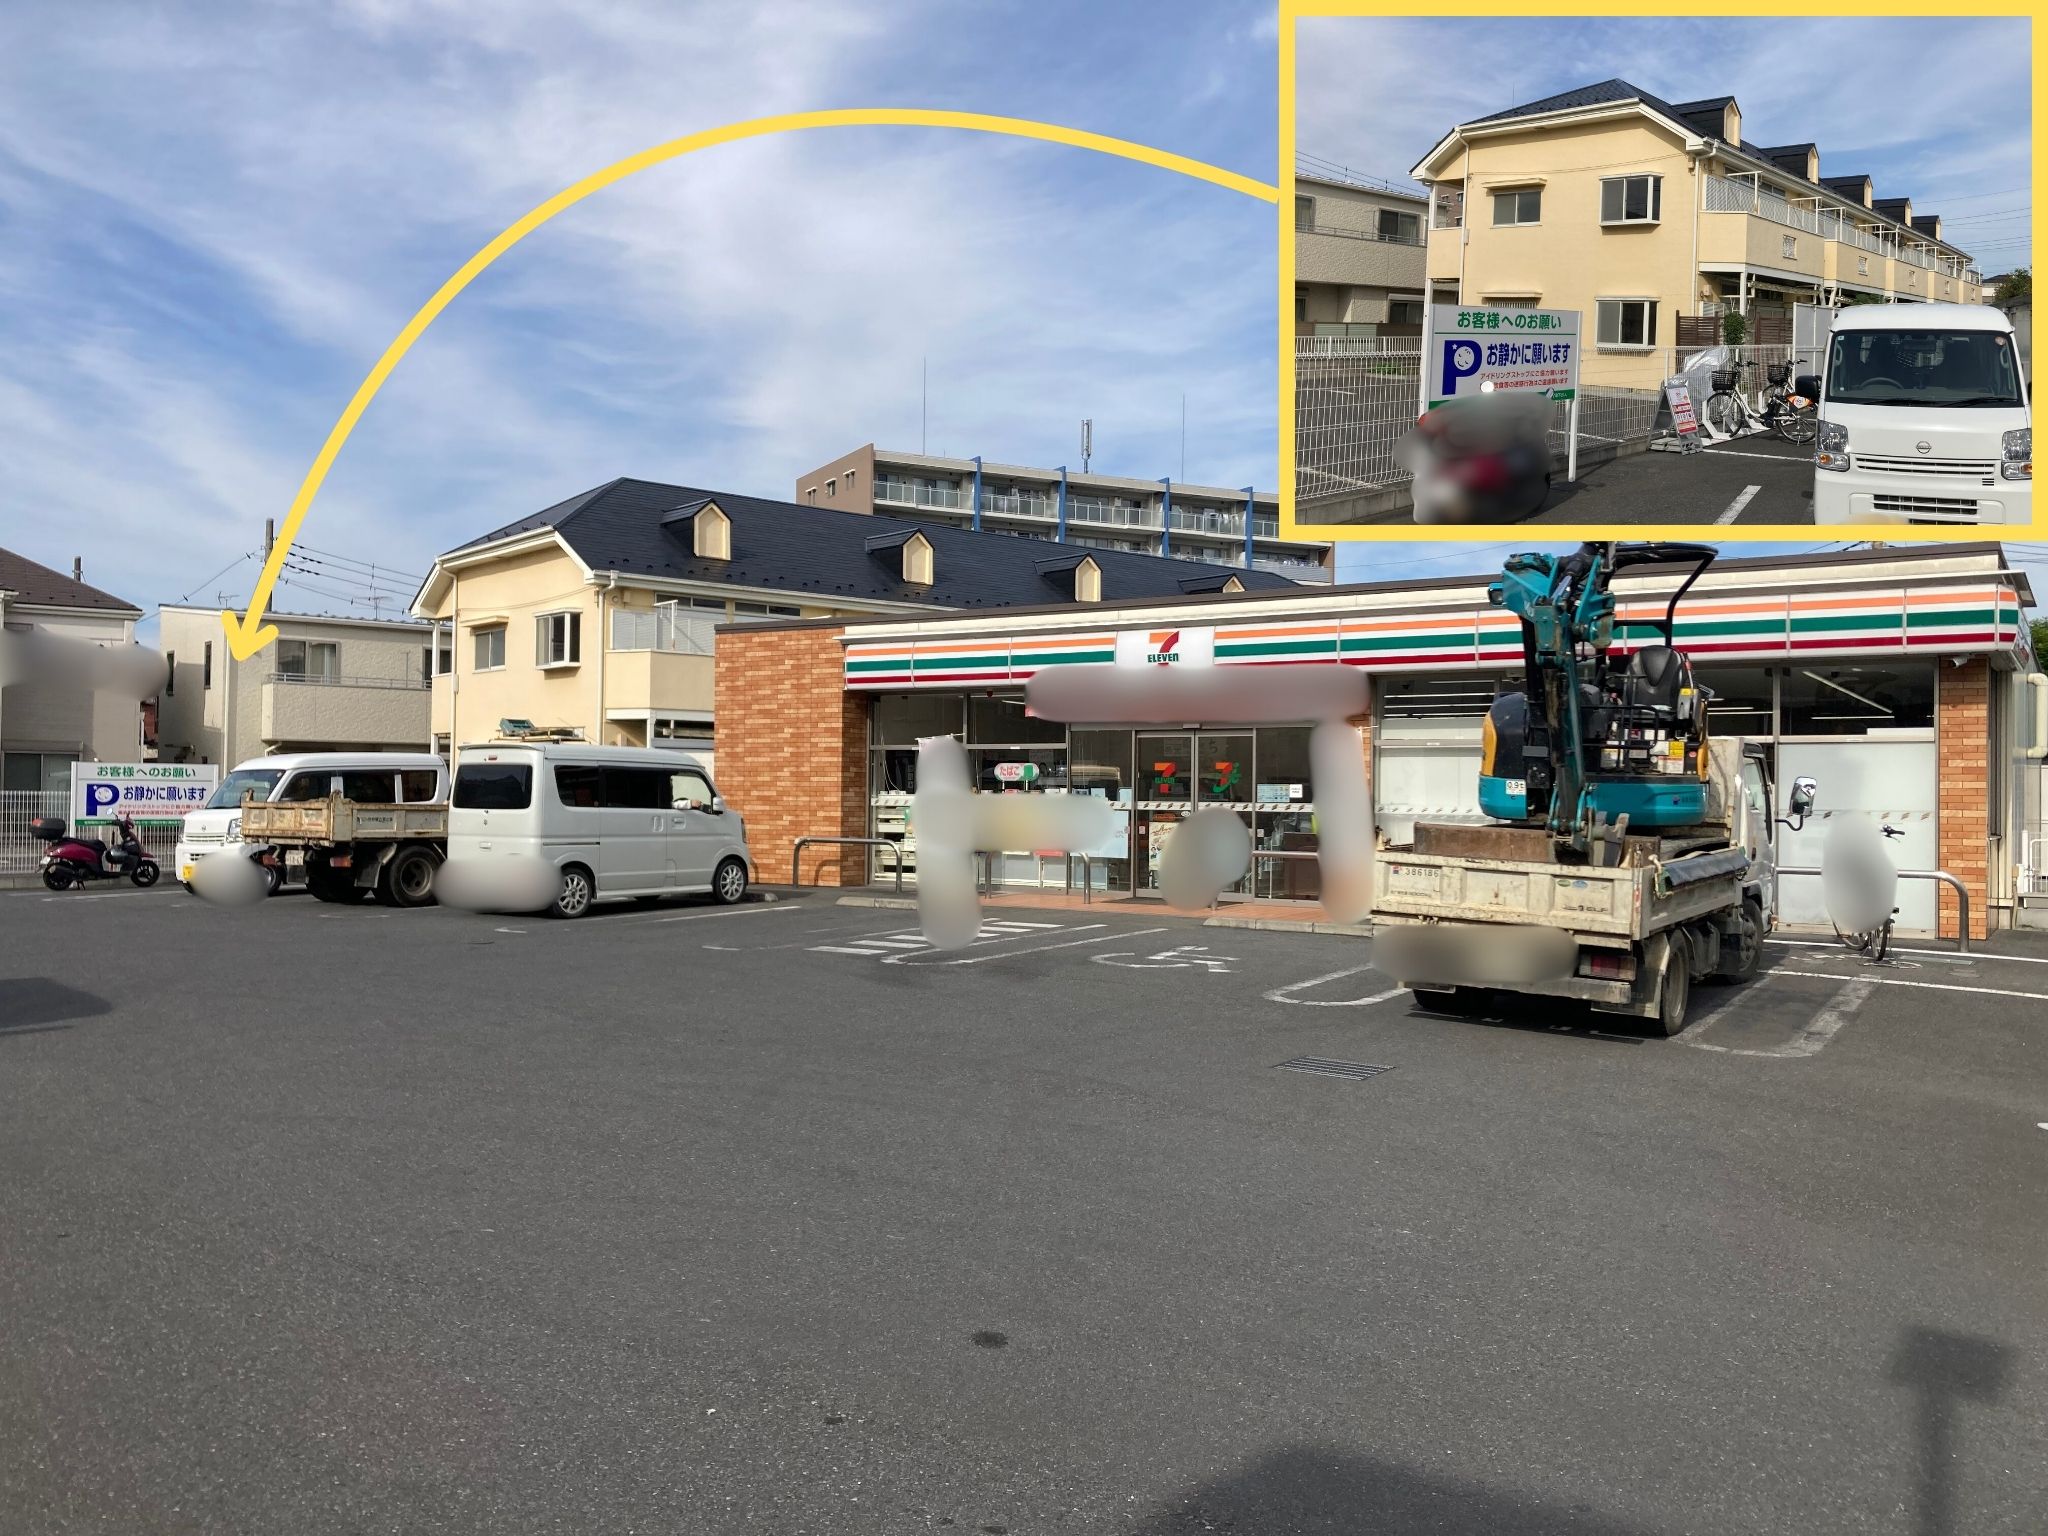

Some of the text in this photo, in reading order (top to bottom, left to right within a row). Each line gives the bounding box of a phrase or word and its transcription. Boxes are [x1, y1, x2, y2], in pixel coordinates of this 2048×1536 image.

[1457, 311, 1562, 330] お客様へのお願い
[1486, 342, 1571, 366] お静かに願います
[1442, 340, 1482, 395] P
[1149, 630, 1180, 666] 7
[97, 765, 196, 778] お客様へのお願い
[1000, 765, 1021, 777] たばこ
[86, 784, 120, 816] P
[123, 785, 207, 801] お静かに願います
[1405, 867, 1439, 878] 386186
